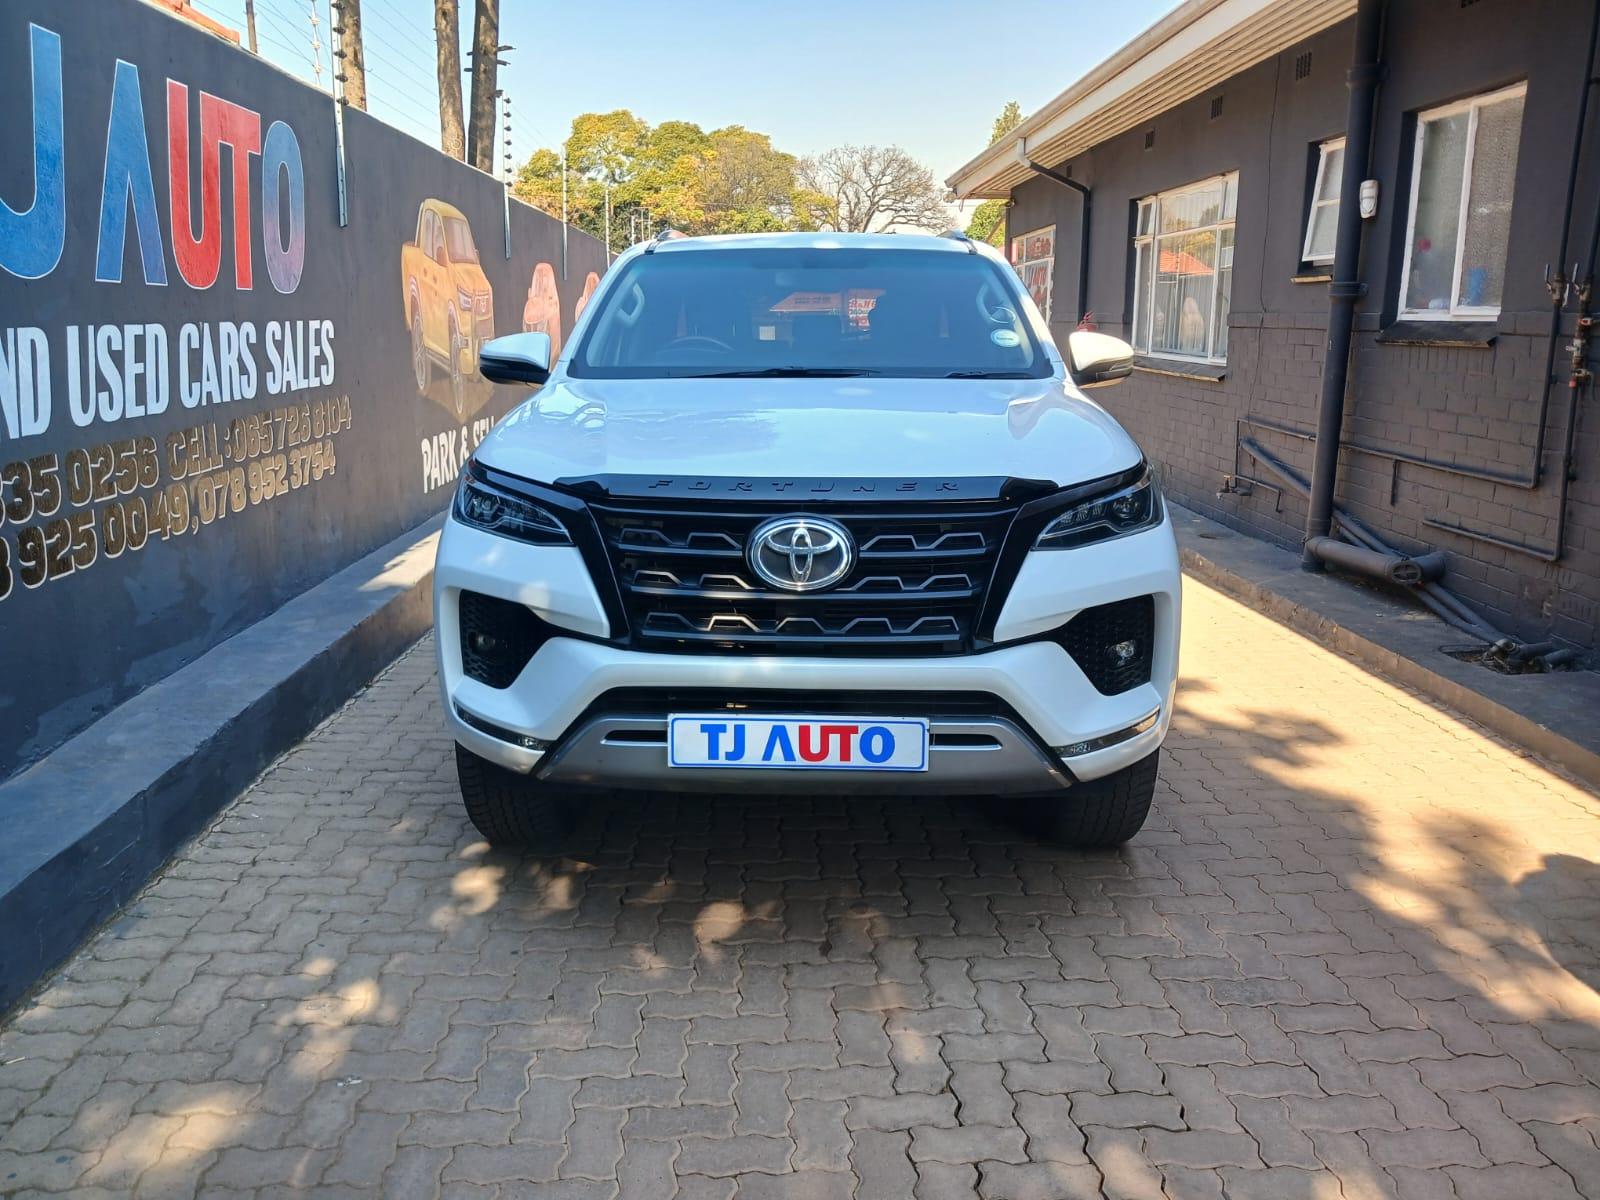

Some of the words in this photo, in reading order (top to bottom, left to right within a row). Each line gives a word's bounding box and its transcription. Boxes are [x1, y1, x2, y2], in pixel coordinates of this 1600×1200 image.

[95, 58, 305, 294] AUTO
[66, 323, 169, 427] USED
[178, 321, 257, 408] CARS
[265, 319, 335, 395] SALES
[0, 453, 62, 530] 35
[65, 436, 159, 507] 0256
[421, 429, 459, 494] PARK
[648, 479, 958, 493] FORTUNER
[17, 509, 98, 589] 925
[700, 723, 745, 761] TJ
[761, 725, 896, 764] AUTO
